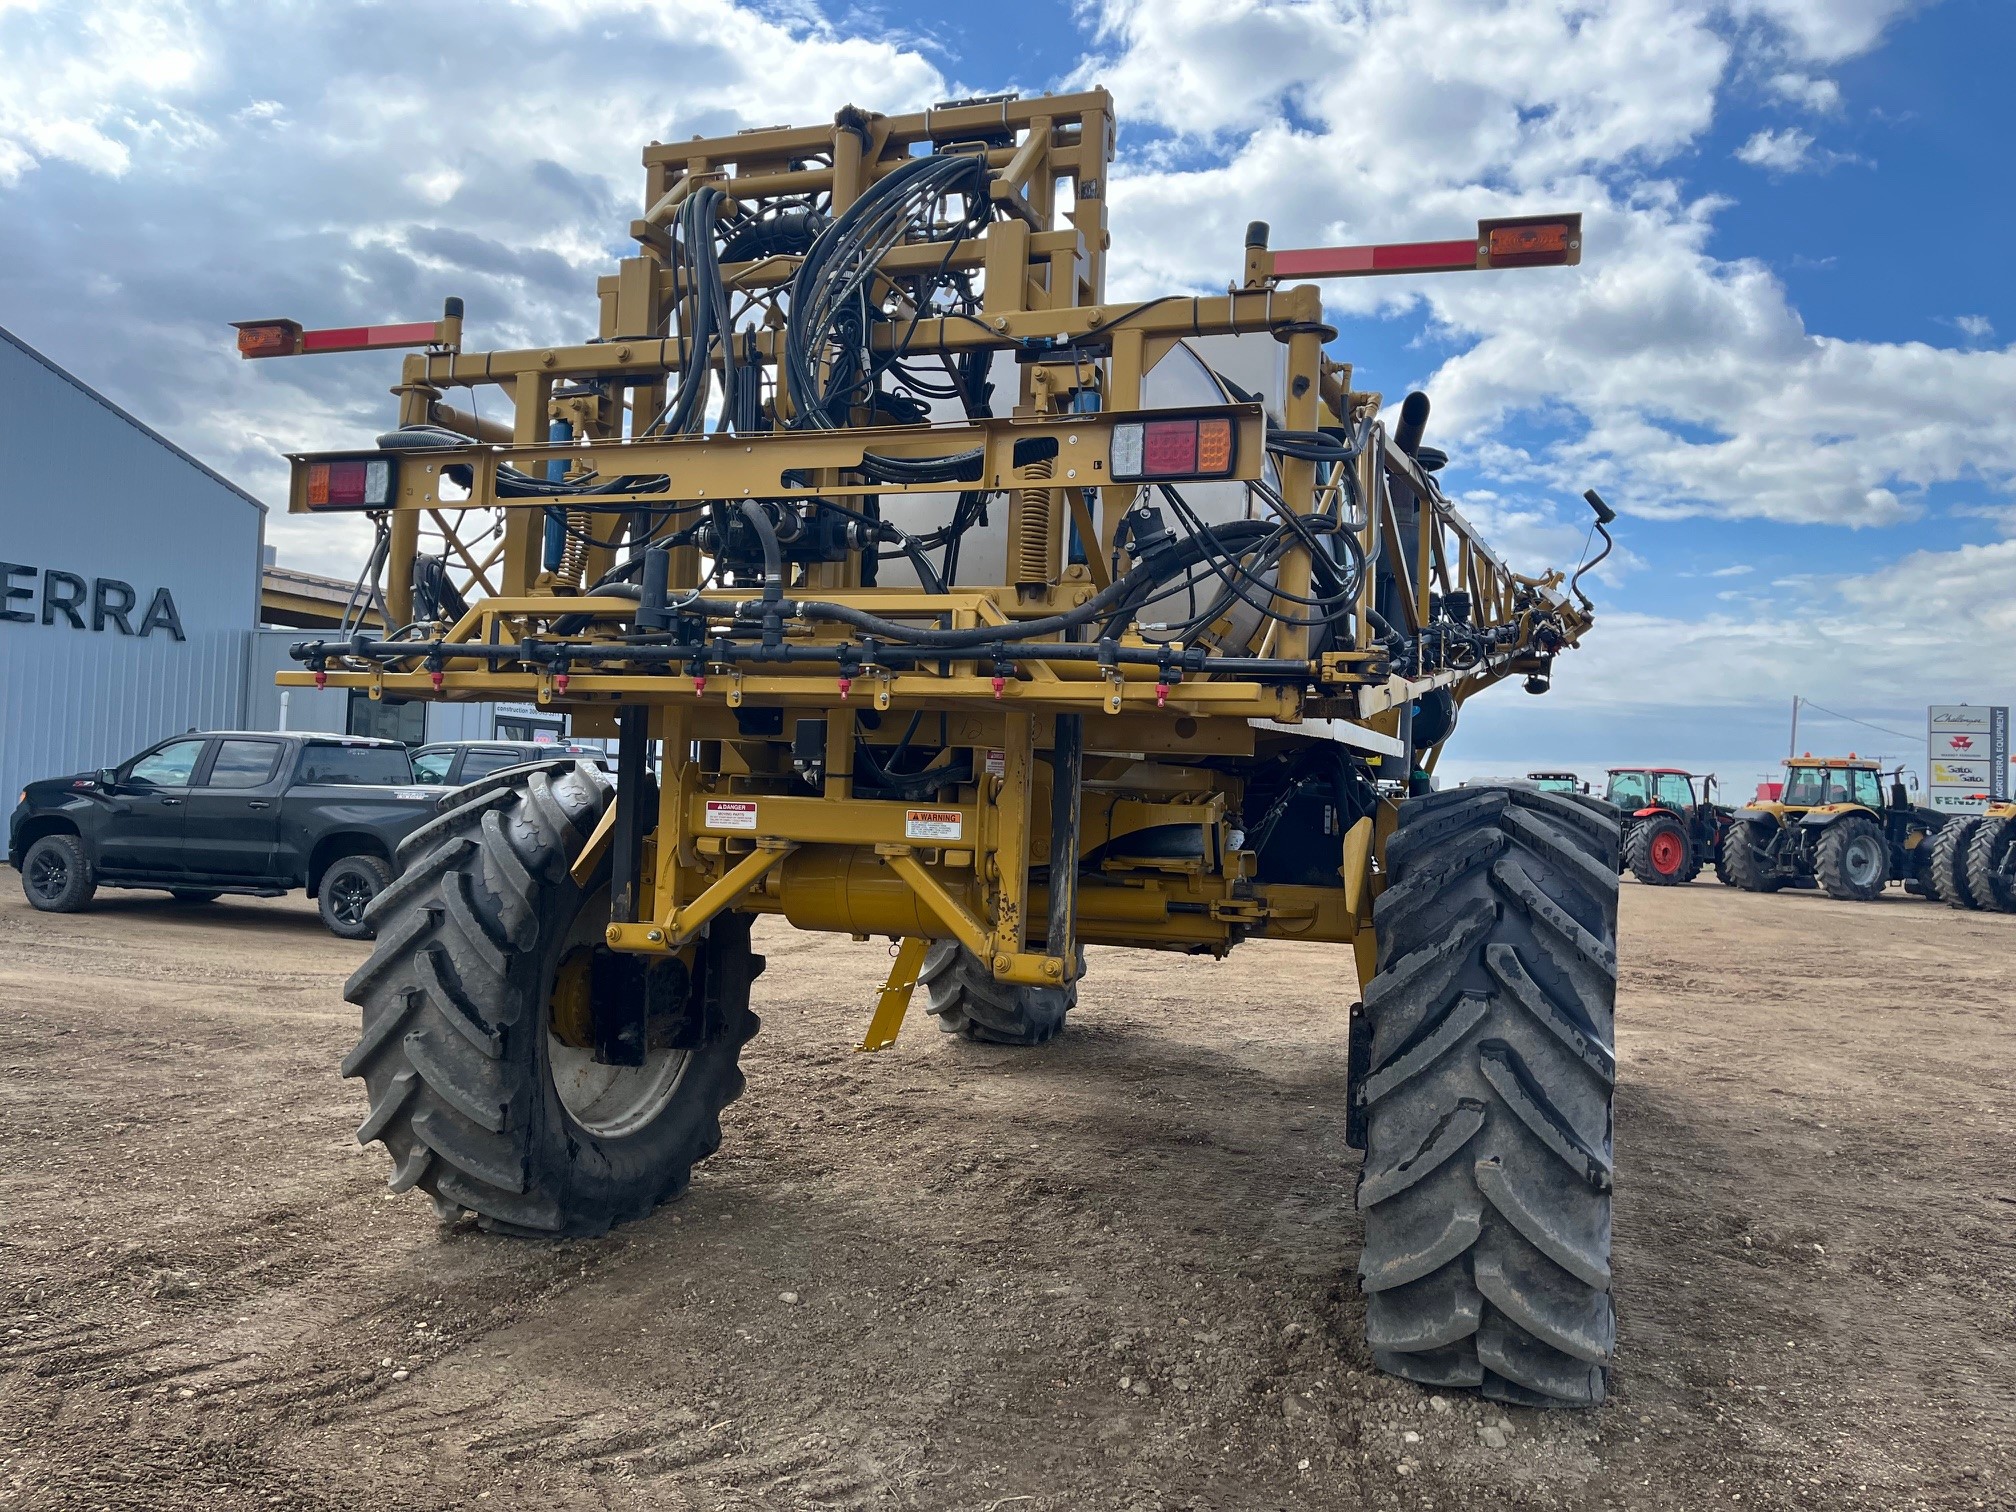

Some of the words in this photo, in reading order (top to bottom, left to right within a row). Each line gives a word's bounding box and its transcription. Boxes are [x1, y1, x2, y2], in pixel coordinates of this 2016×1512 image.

[497, 705, 528, 714] construction
[1996, 710, 2004, 753] EQUIPMENT
[1995, 754, 2004, 798] AGRITERRA
[921, 813, 956, 822] WARNING
